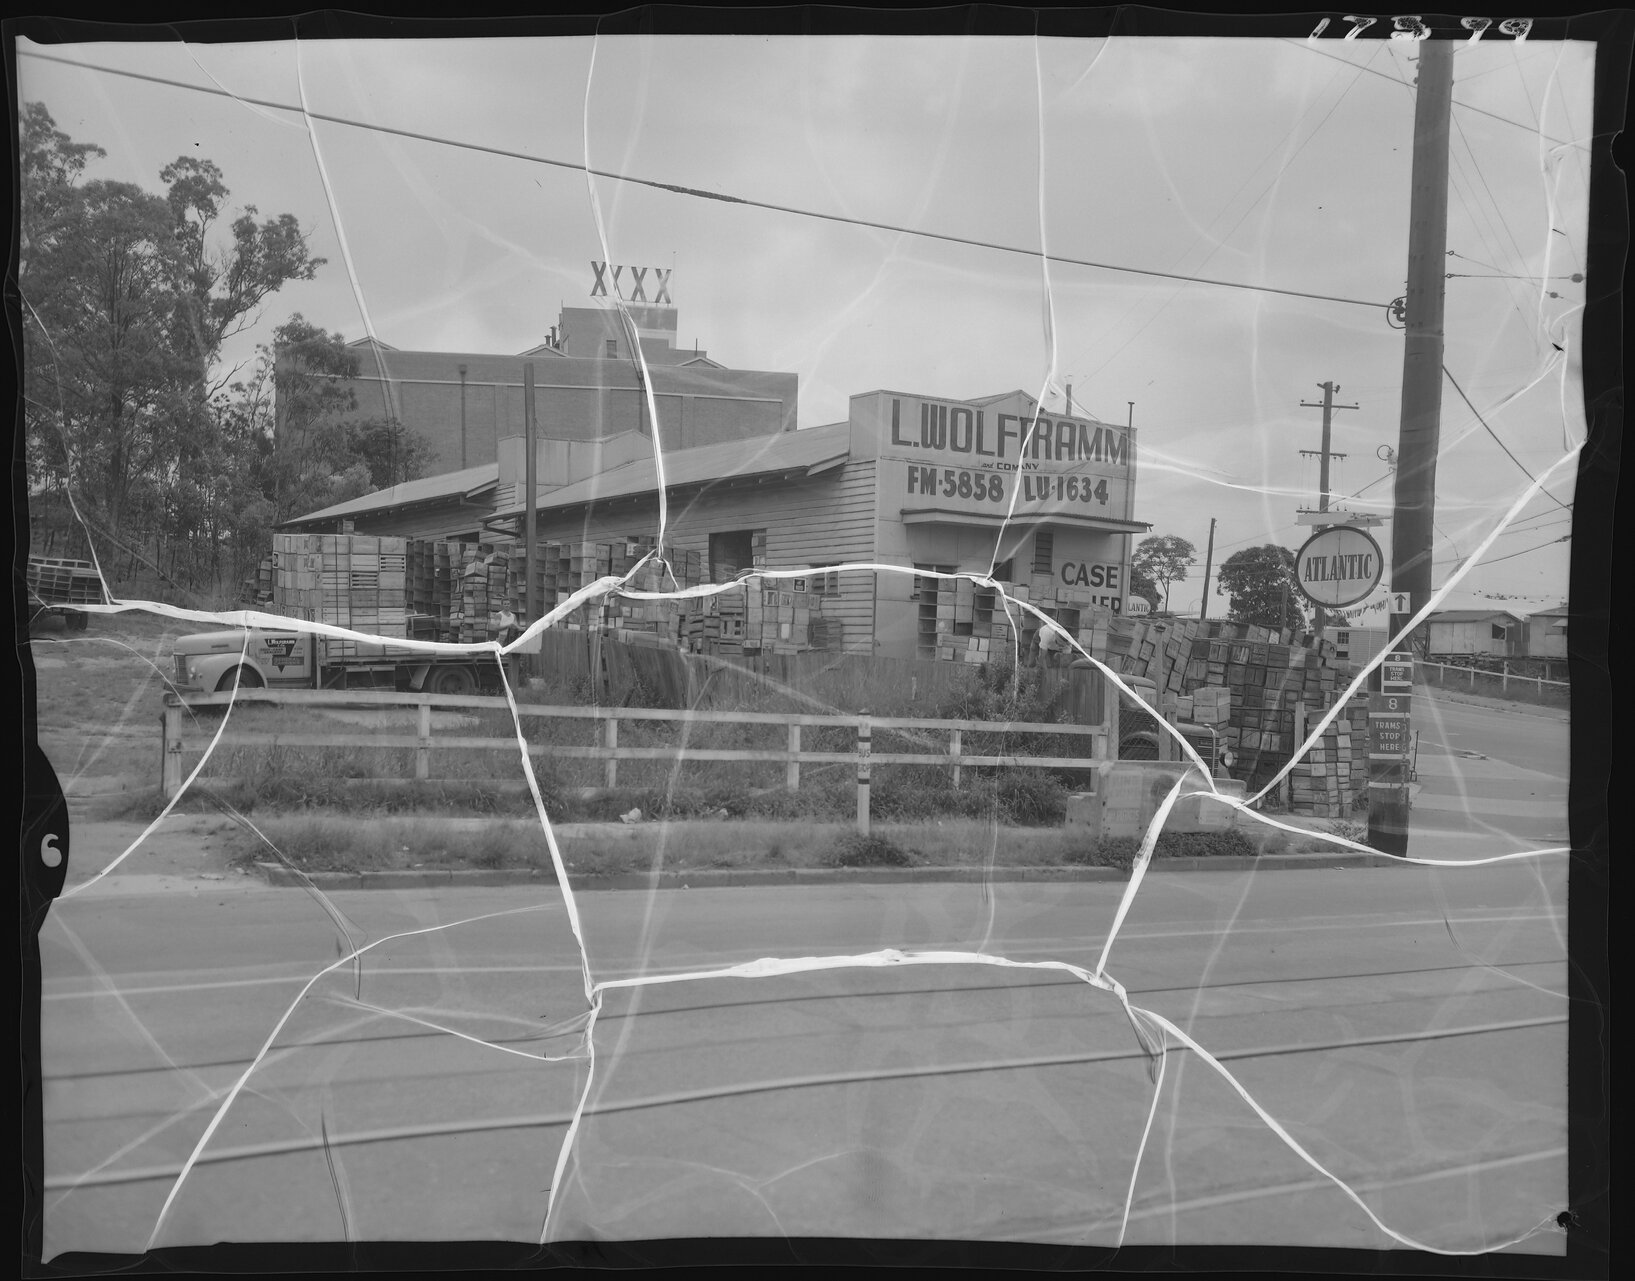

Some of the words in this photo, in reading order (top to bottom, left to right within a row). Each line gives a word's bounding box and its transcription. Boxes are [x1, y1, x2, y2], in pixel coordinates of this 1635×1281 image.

[590, 261, 672, 304] XXXX
[1304, 554, 1372, 582] ATLANTIC
[1061, 562, 1118, 589] CASE
[1394, 654, 1401, 662] 8
[1388, 698, 1398, 710] 8
[1375, 721, 1401, 730] TRAMS
[1379, 732, 1401, 740] STOP
[1380, 743, 1400, 751] HERE
